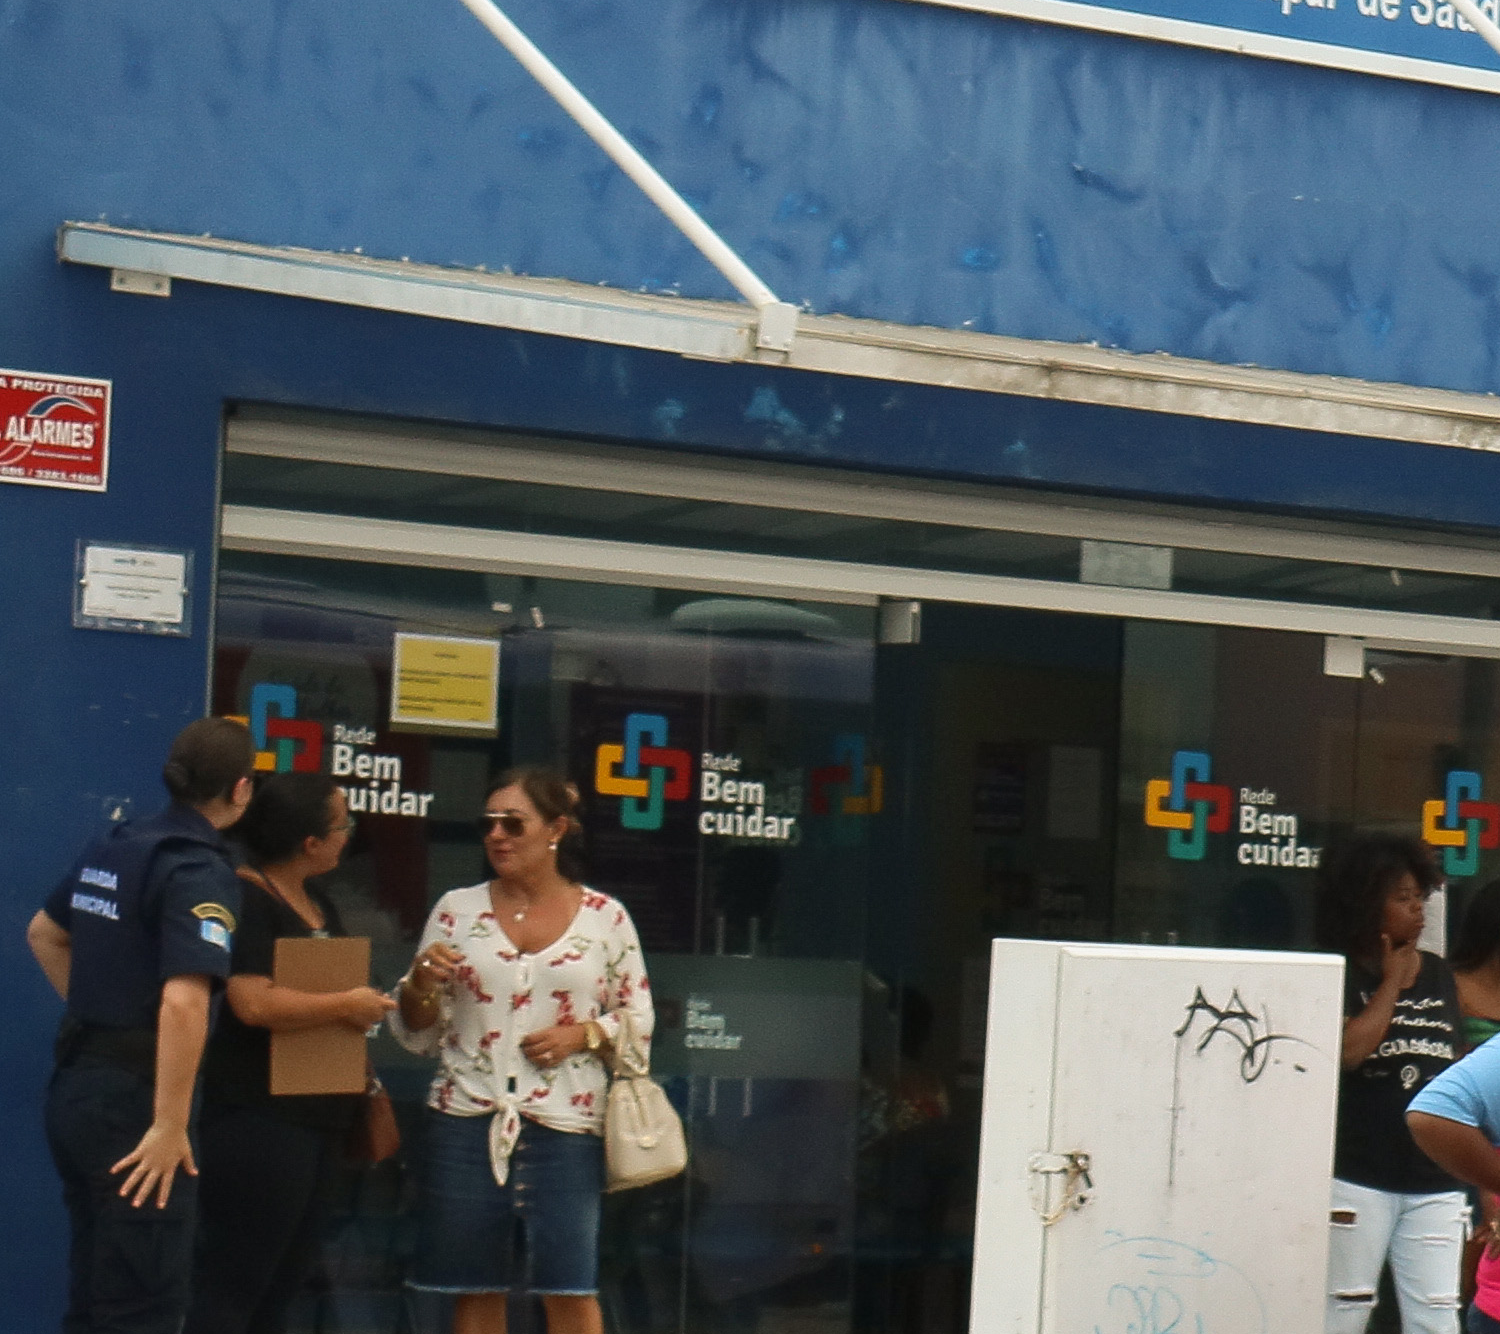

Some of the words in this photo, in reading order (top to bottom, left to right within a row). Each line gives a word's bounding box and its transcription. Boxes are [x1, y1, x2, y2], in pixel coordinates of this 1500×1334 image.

[11, 378, 104, 399] PROTEGIDA
[5, 415, 95, 449] ALARMES
[332, 744, 401, 781] Bem
[700, 771, 766, 805] Bem
[1239, 787, 1277, 805] Rede
[698, 805, 797, 840] cuidar
[1239, 805, 1298, 836] Bem
